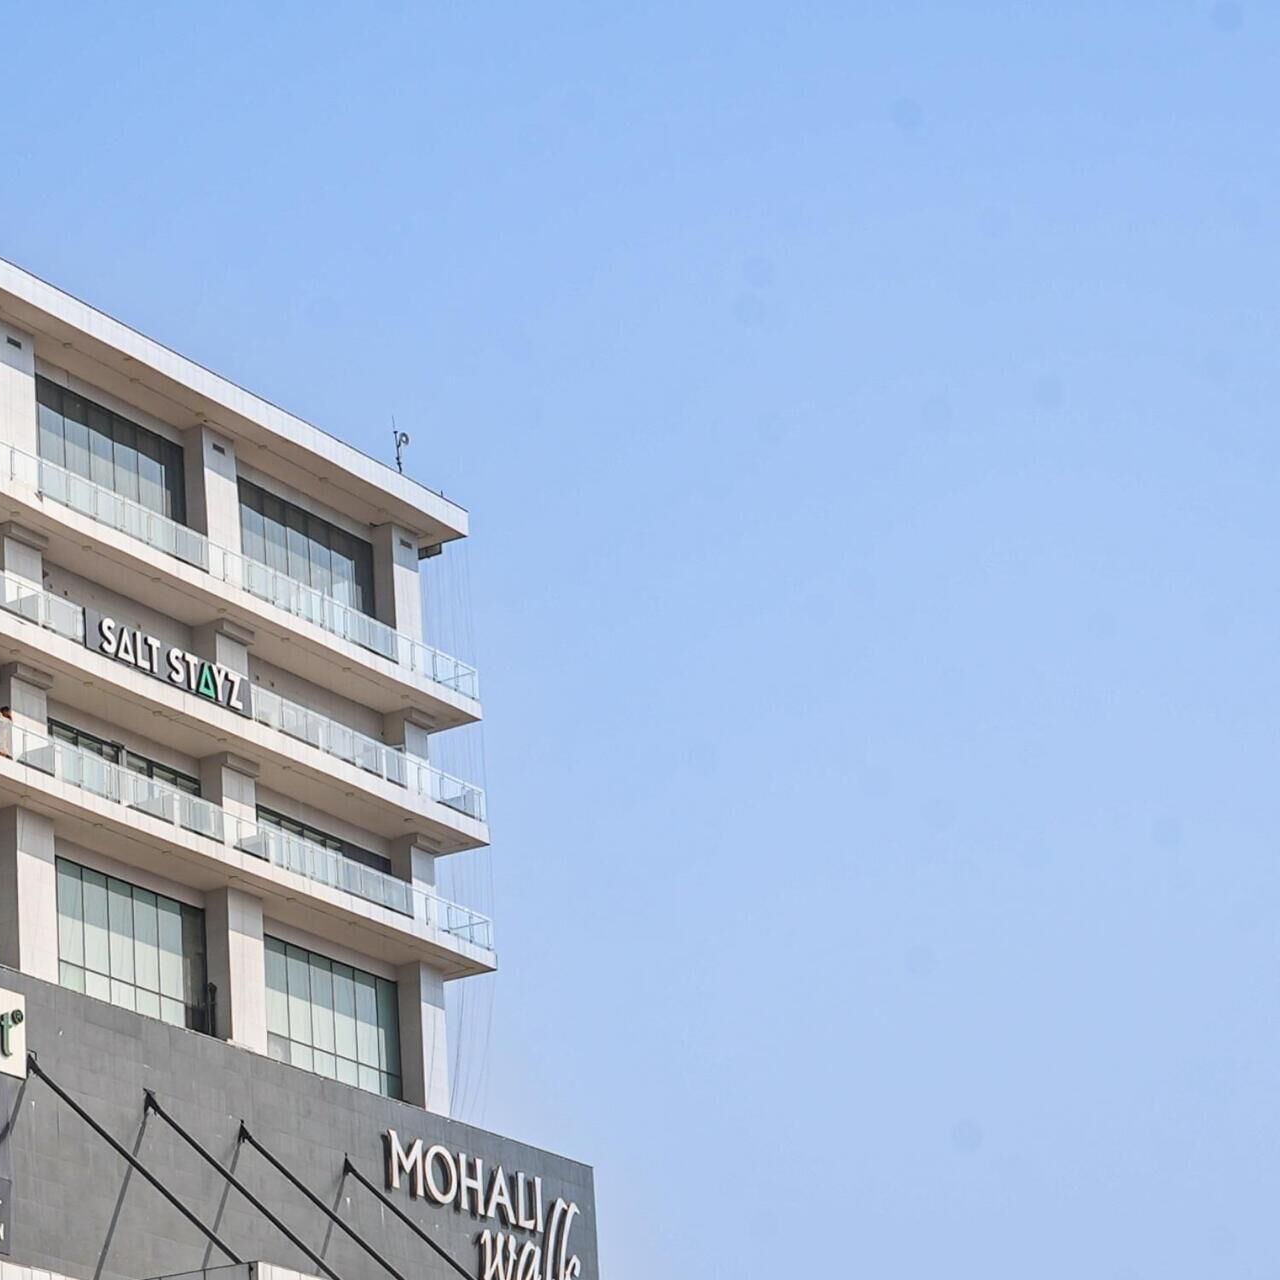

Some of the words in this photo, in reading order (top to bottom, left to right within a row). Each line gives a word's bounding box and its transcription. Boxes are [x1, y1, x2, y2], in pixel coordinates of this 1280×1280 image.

[98, 616, 162, 676] SALT
[166, 648, 245, 712] STAYZ
[384, 1128, 548, 1234] MOHALI
